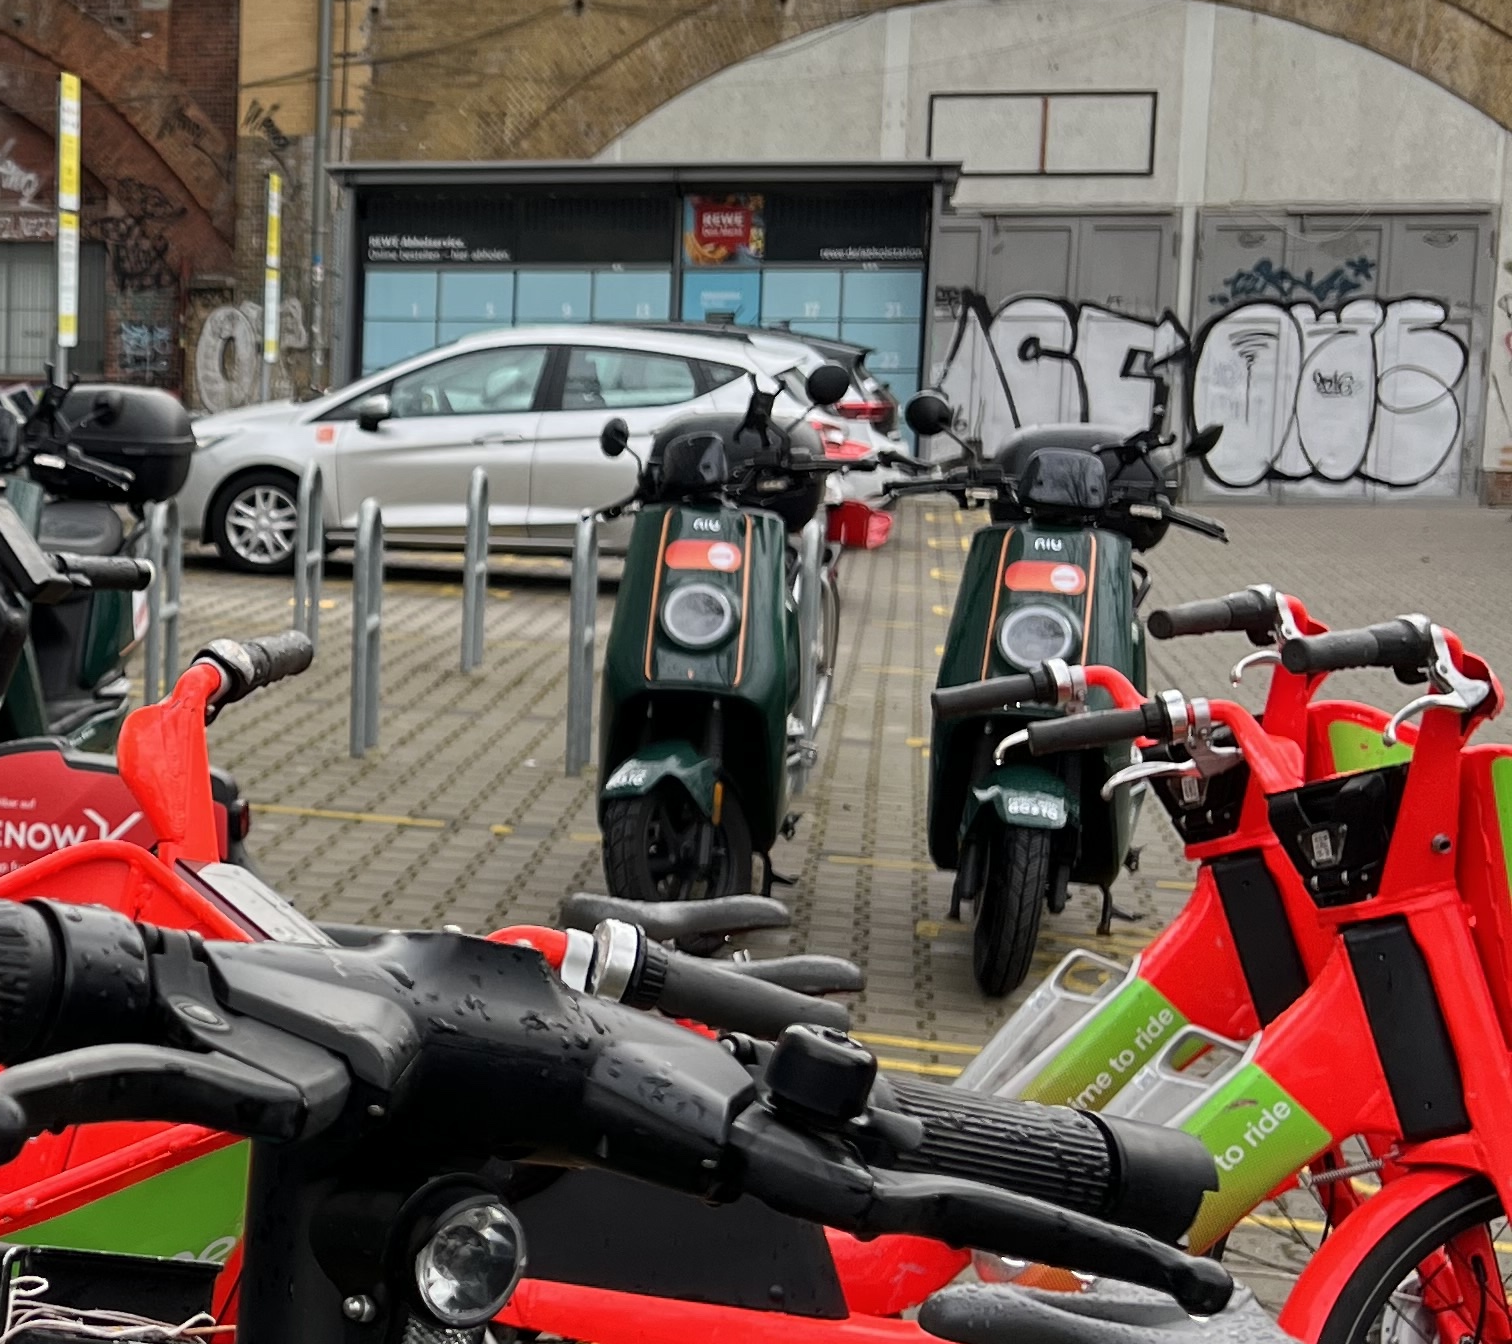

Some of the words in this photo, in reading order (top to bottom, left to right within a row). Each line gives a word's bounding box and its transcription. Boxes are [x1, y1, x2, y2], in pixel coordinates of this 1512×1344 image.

[368, 234, 400, 249] REWE
[702, 212, 745, 228] REWE
[1068, 1069, 1114, 1112] ime
[1108, 1048, 1136, 1076] to
[1132, 1006, 1175, 1050] ride
[1213, 1142, 1245, 1174] to
[1242, 1100, 1292, 1150] ride
